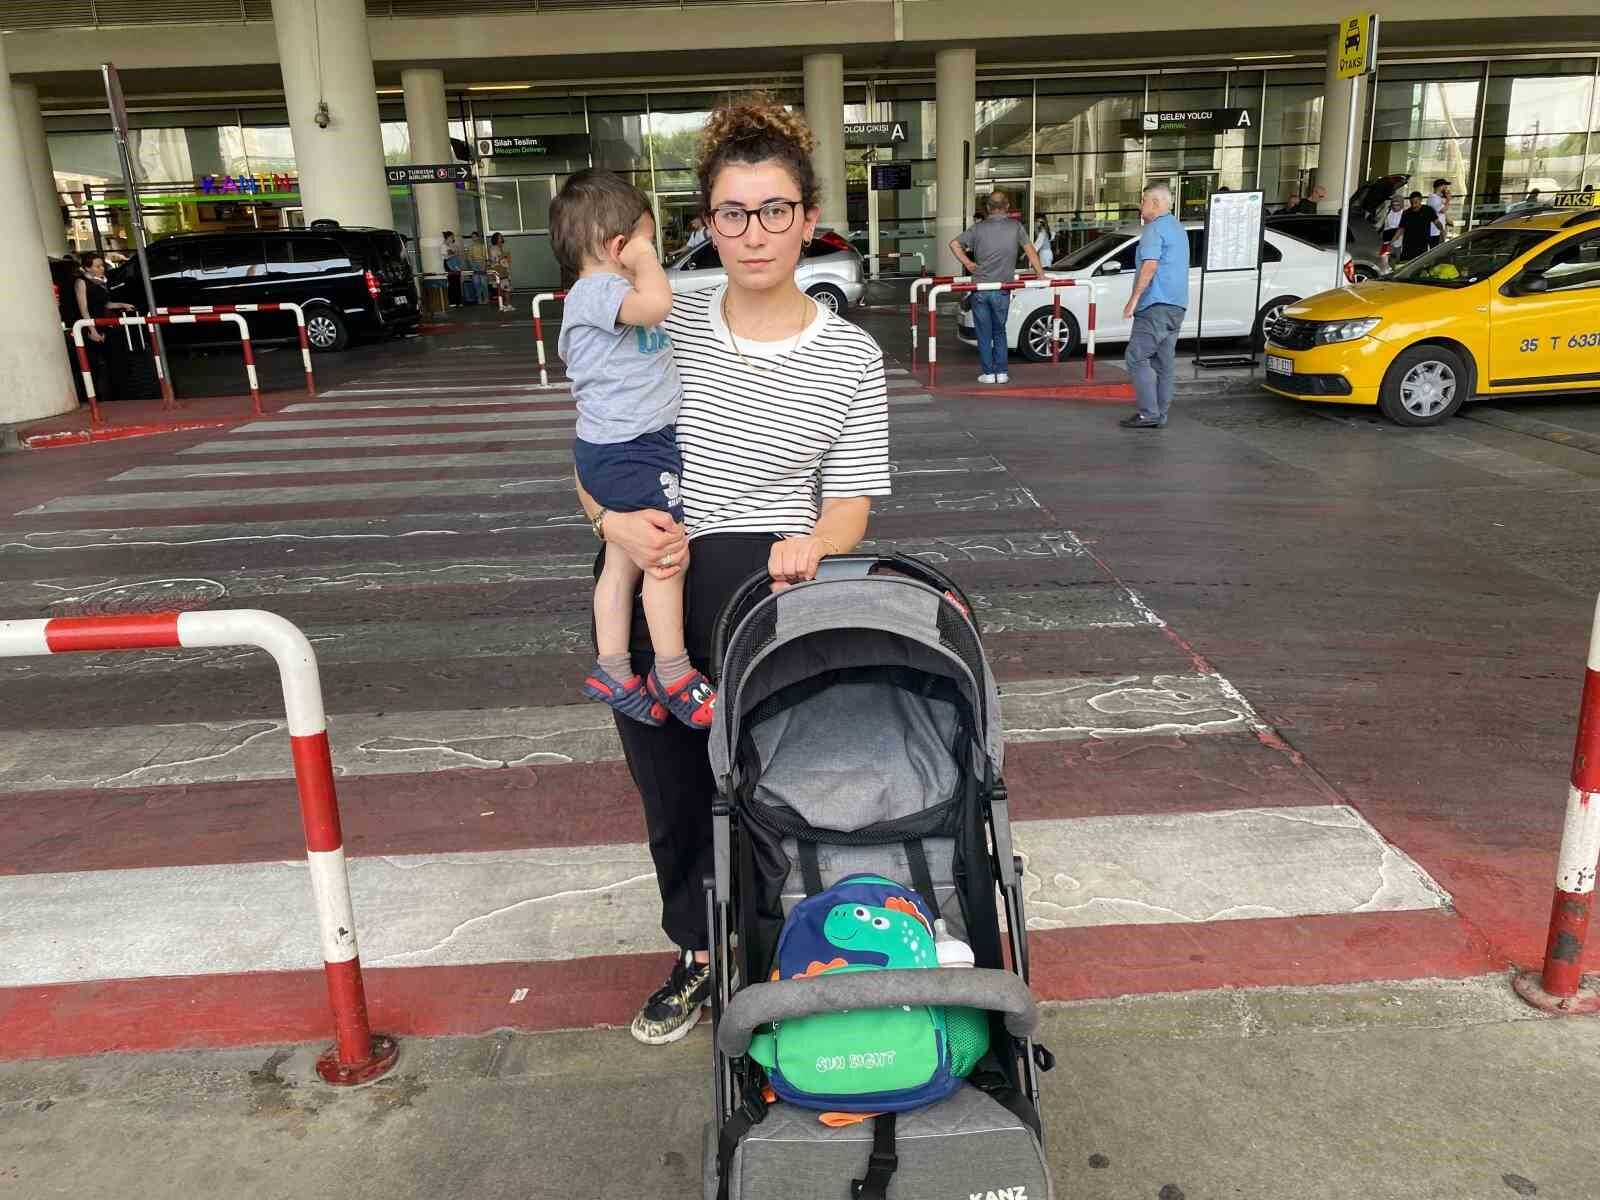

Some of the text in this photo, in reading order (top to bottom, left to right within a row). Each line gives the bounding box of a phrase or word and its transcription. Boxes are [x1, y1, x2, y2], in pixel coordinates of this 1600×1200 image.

[1187, 111, 1213, 120] YOLCU
[1237, 110, 1251, 126] A
[844, 125, 865, 133] OLCU
[891, 123, 905, 140] A
[514, 138, 538, 146] Teslim
[388, 170, 406, 181] CIP
[1520, 338, 1539, 352] 35
[1550, 336, 1561, 351] T
[815, 1056, 845, 1072] SUN
